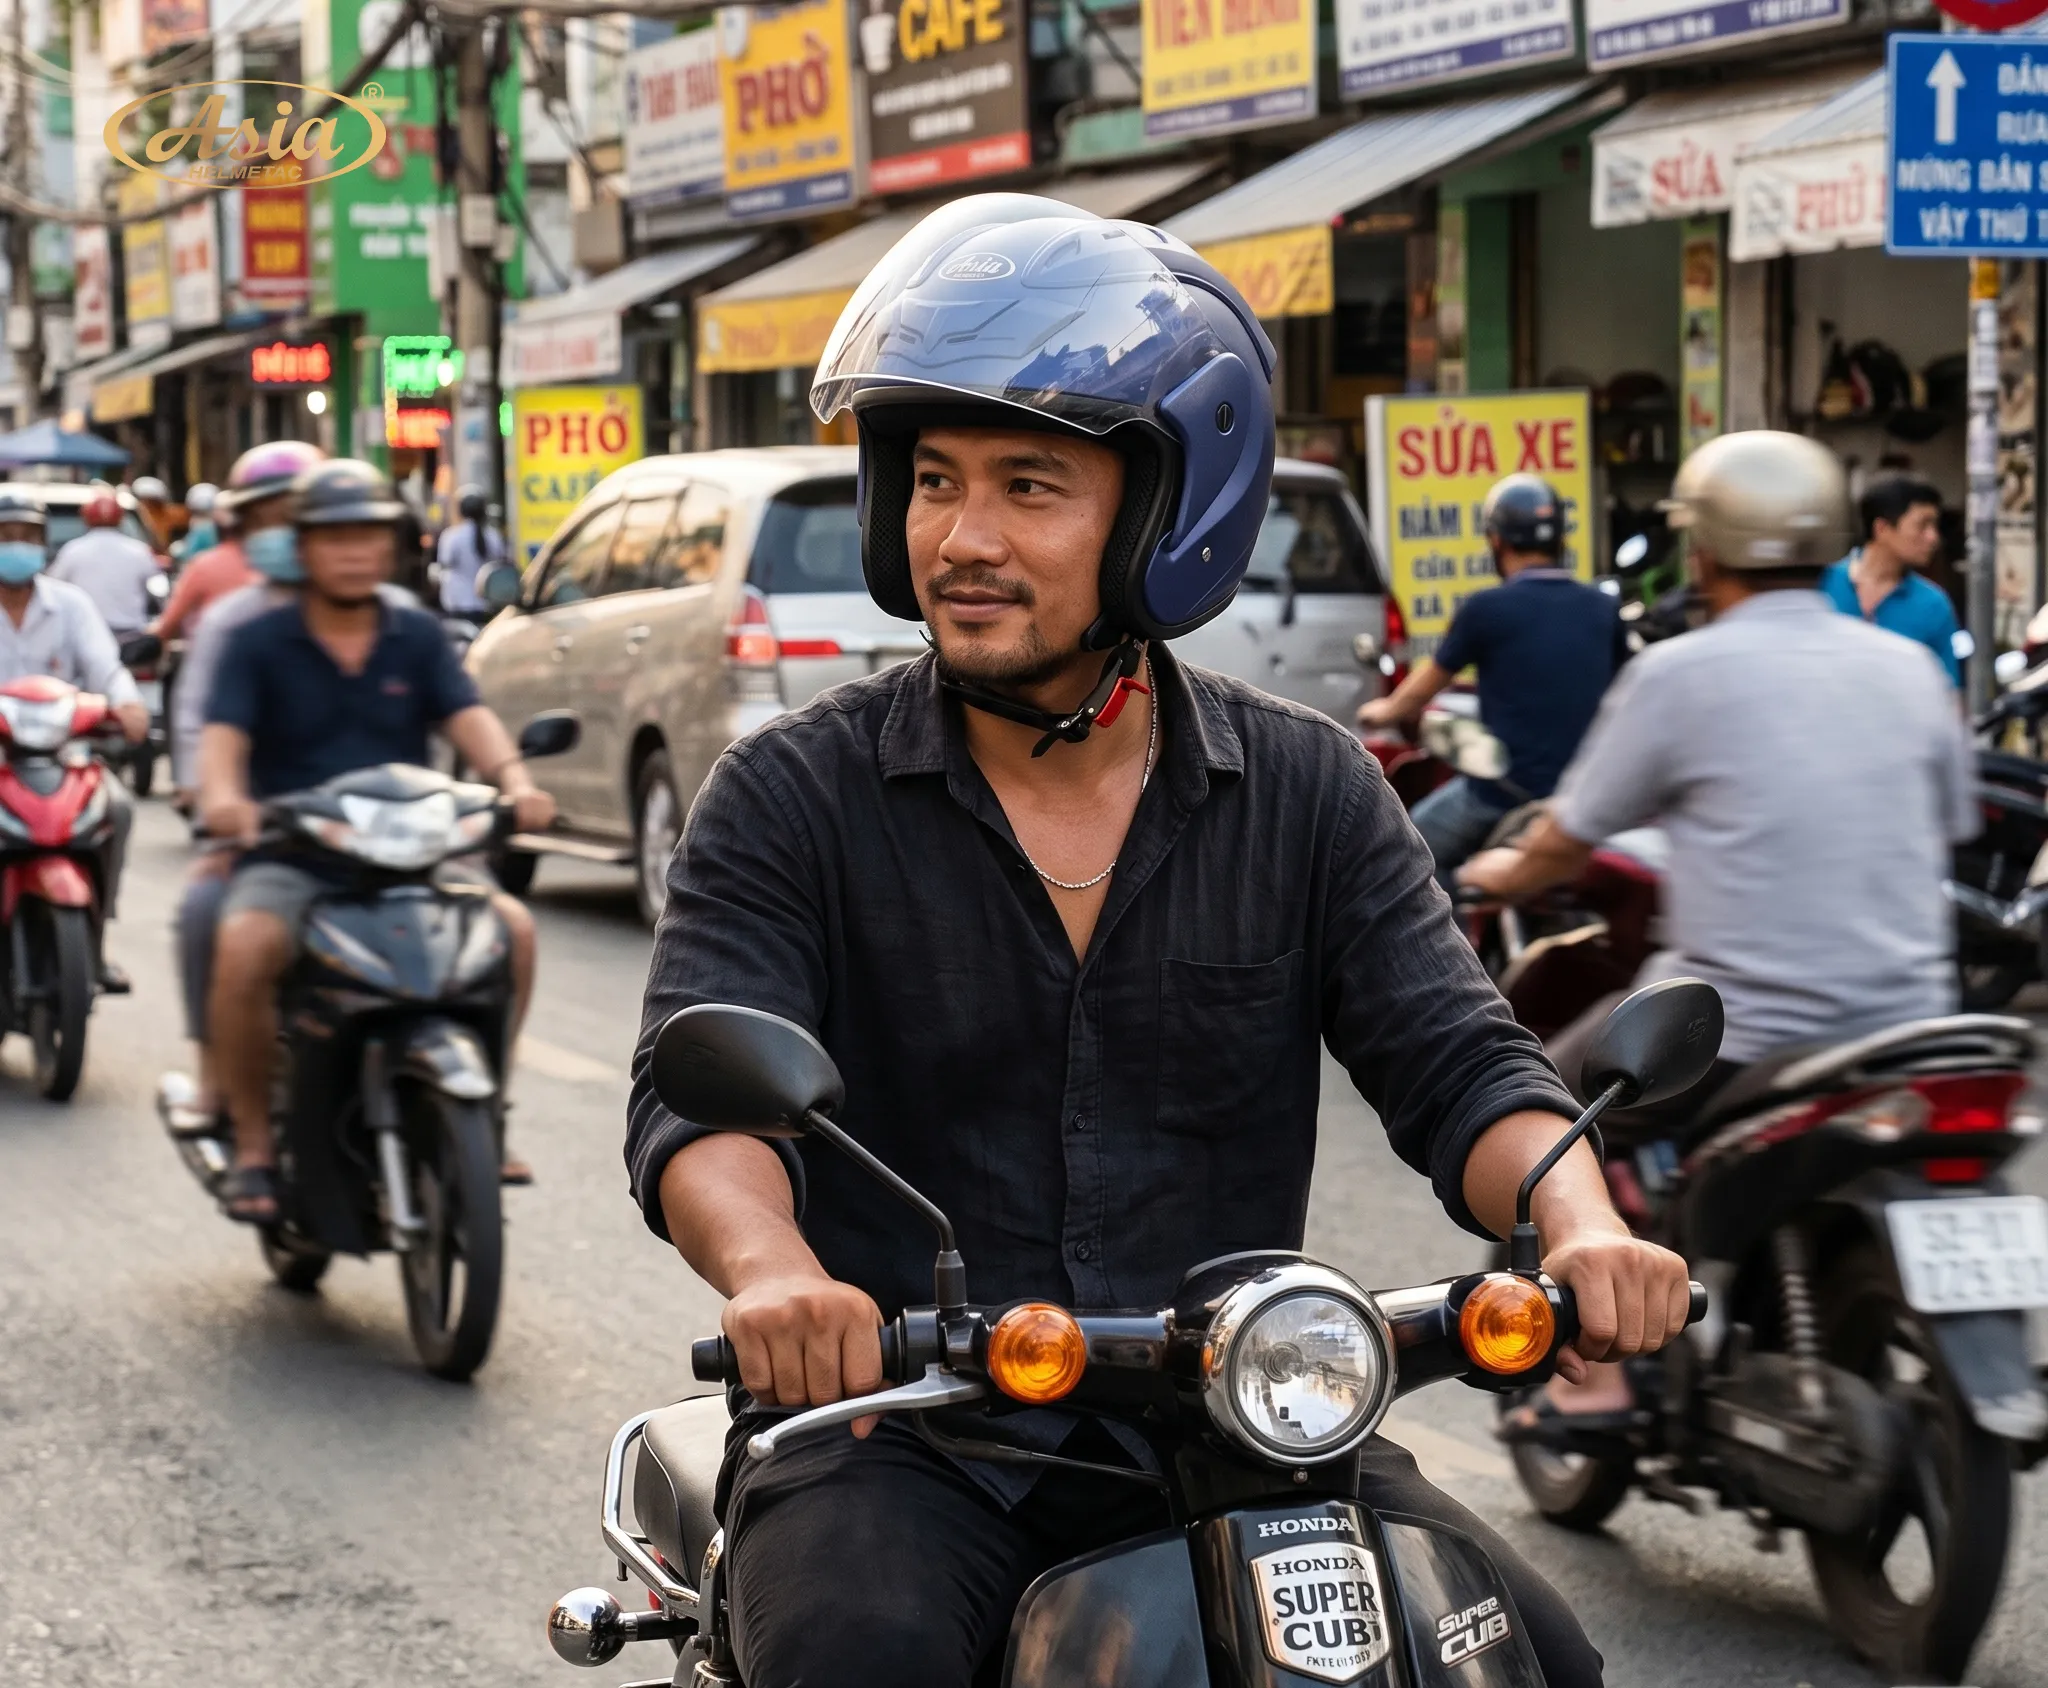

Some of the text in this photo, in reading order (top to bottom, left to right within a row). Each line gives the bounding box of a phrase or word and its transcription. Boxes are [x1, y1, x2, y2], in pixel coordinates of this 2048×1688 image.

[1515, 418, 1577, 472] XE
[1257, 1517, 1356, 1538] HONDA
[1271, 1556, 1366, 1576] HONDA
[1273, 1581, 1381, 1619] SUPER
[1437, 1596, 1499, 1640] SUPER
[1441, 1612, 1509, 1664] CUB
